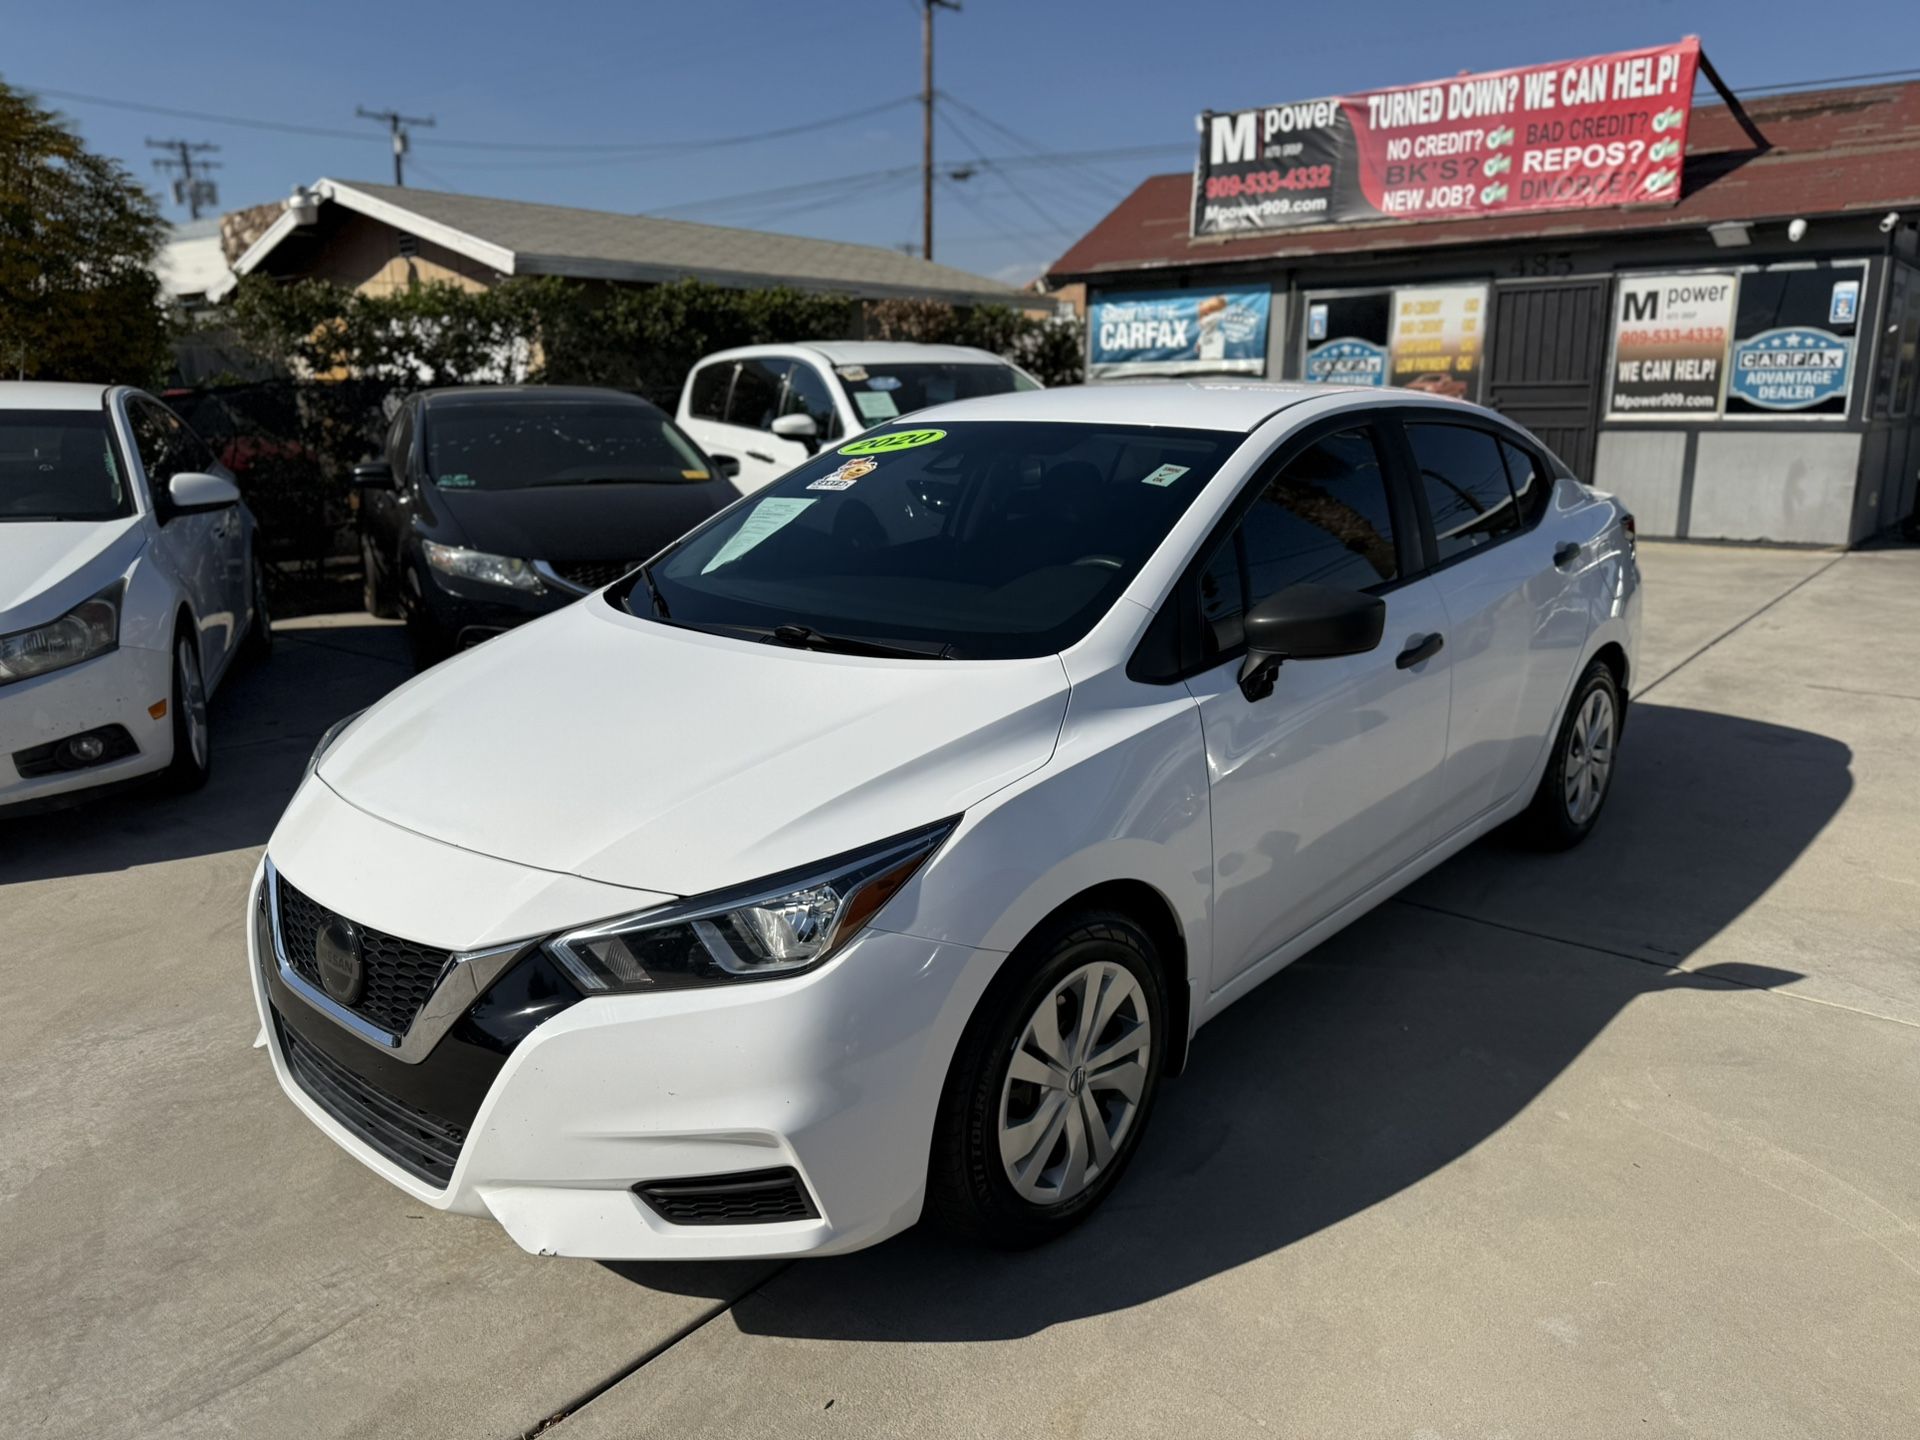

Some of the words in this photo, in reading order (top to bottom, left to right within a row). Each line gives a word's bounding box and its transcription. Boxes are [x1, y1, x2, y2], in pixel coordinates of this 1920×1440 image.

[1368, 87, 1444, 130] TURNED
[1447, 75, 1519, 120] DOWN?
[1524, 71, 1557, 110] WE
[1561, 63, 1608, 106] CAN
[1612, 54, 1680, 100] HELP!
[1211, 112, 1256, 165] M
[1264, 100, 1339, 142] power
[1526, 120, 1564, 145] BAD
[1569, 112, 1649, 141] CREDIT?
[1387, 138, 1411, 161] NO
[1414, 129, 1484, 158] CREDIT?
[1522, 140, 1645, 173] REPOS?
[1206, 164, 1331, 199] 909-533-4332
[1385, 157, 1480, 186] BK'S?
[1520, 171, 1638, 201] DIVORCE?
[1382, 189, 1424, 212] NEW
[1426, 184, 1475, 209] JOB?
[1623, 291, 1659, 322] M
[1667, 285, 1728, 309] power
[1101, 319, 1189, 351] CARFAX
[1621, 327, 1724, 345] 909-533-4332
[1619, 361, 1640, 382] WE
[1642, 360, 1672, 382] CAN
[1674, 359, 1716, 381] HELP!
[1742, 351, 1841, 368] CARFAX
[1745, 370, 1833, 386] ADVANTAGE
[1758, 385, 1815, 399] DEALER
[843, 432, 939, 452] 2020
